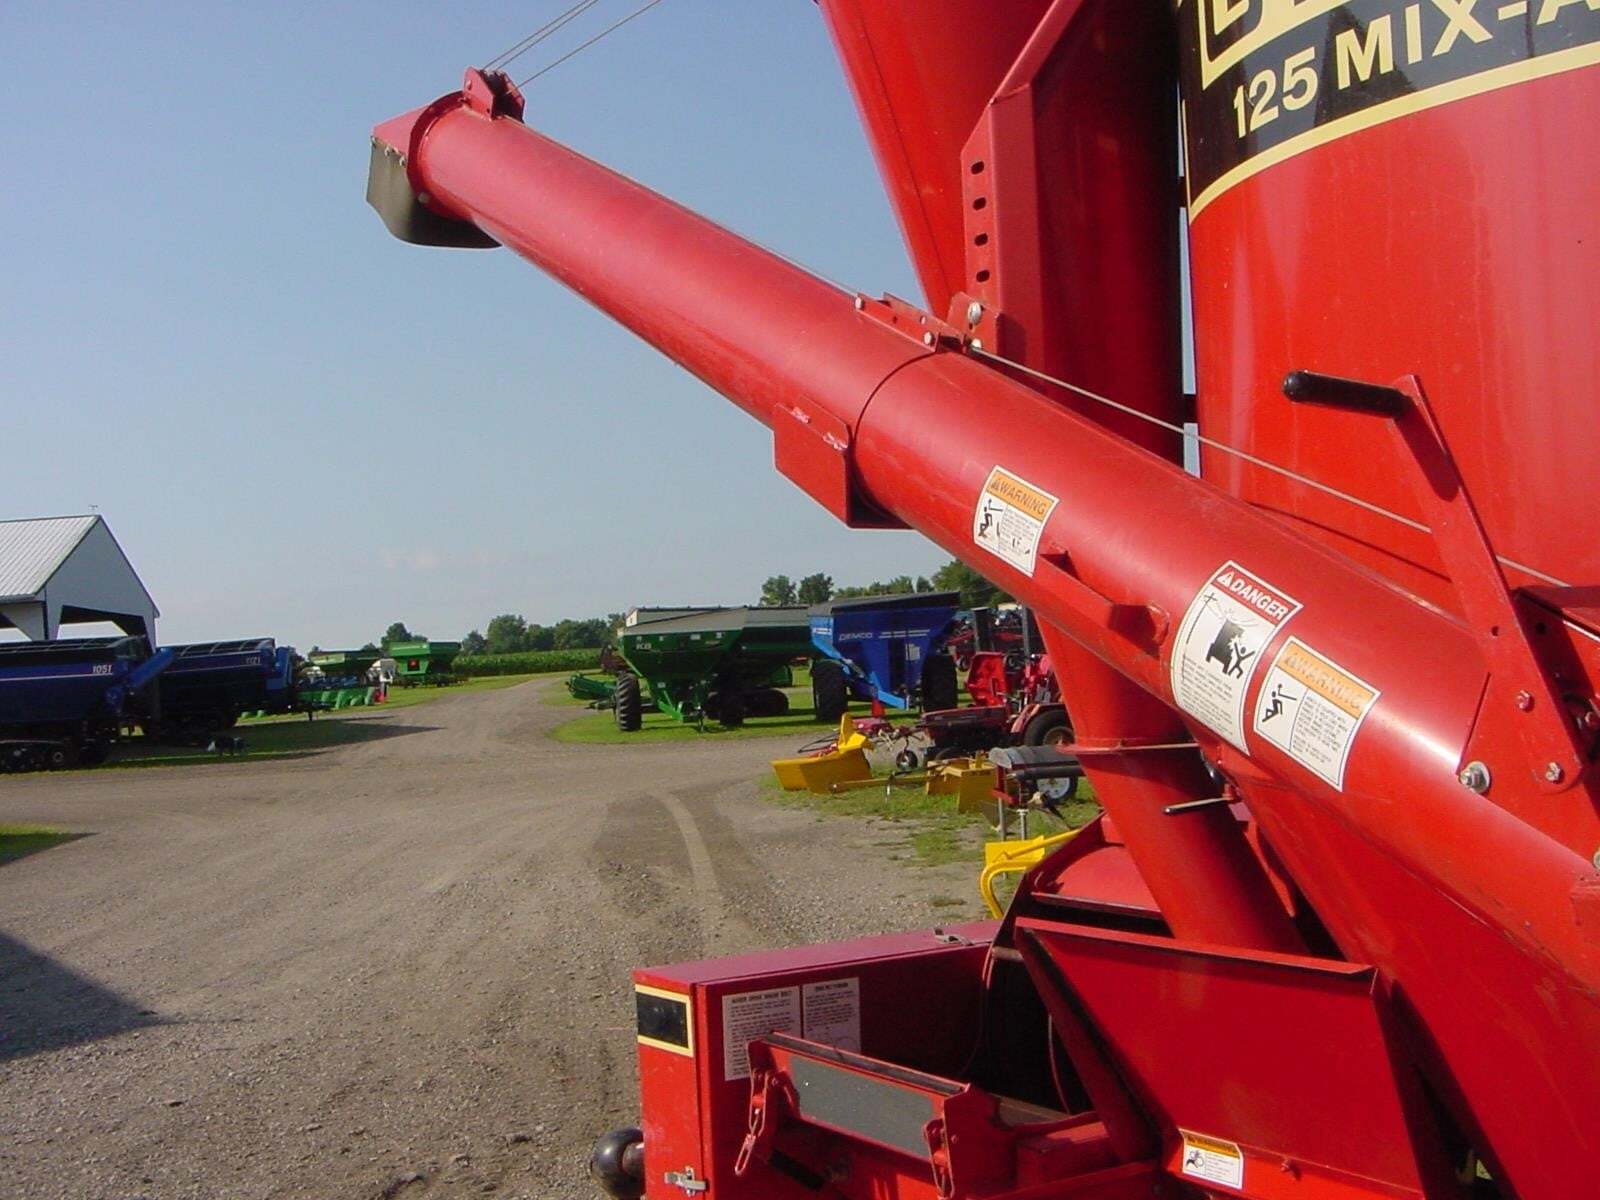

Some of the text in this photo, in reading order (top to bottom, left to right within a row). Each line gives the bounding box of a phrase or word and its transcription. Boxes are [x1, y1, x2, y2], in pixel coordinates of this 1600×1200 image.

[1233, 46, 1319, 139] 125
[998, 480, 1047, 516] WARNING
[1231, 578, 1290, 622] DANGER
[838, 632, 873, 641] DEMCO
[92, 664, 113, 674] 1051
[1295, 656, 1365, 710] WARNING
